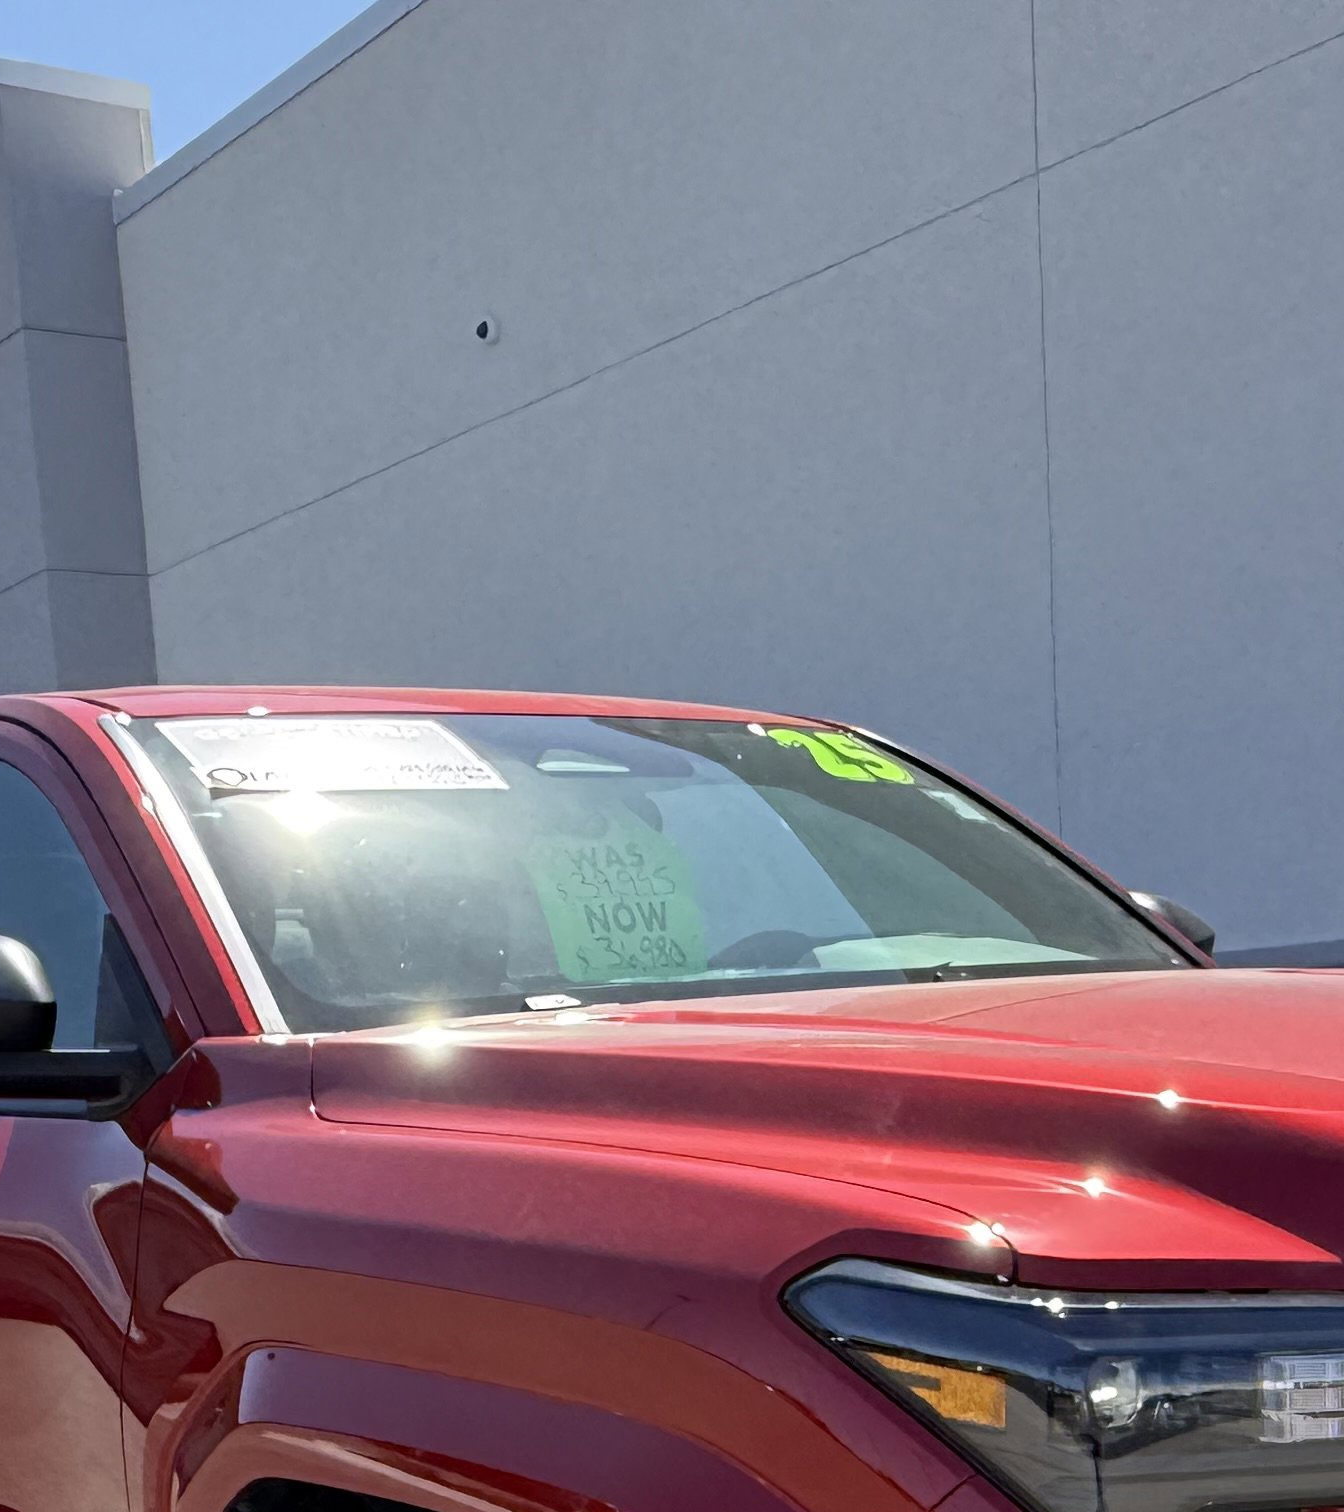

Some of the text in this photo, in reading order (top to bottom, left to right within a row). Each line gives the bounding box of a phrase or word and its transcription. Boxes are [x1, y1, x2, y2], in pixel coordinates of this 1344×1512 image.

[766, 728, 915, 785] 25
[564, 843, 645, 873] WAS
[583, 901, 667, 935] NOW
